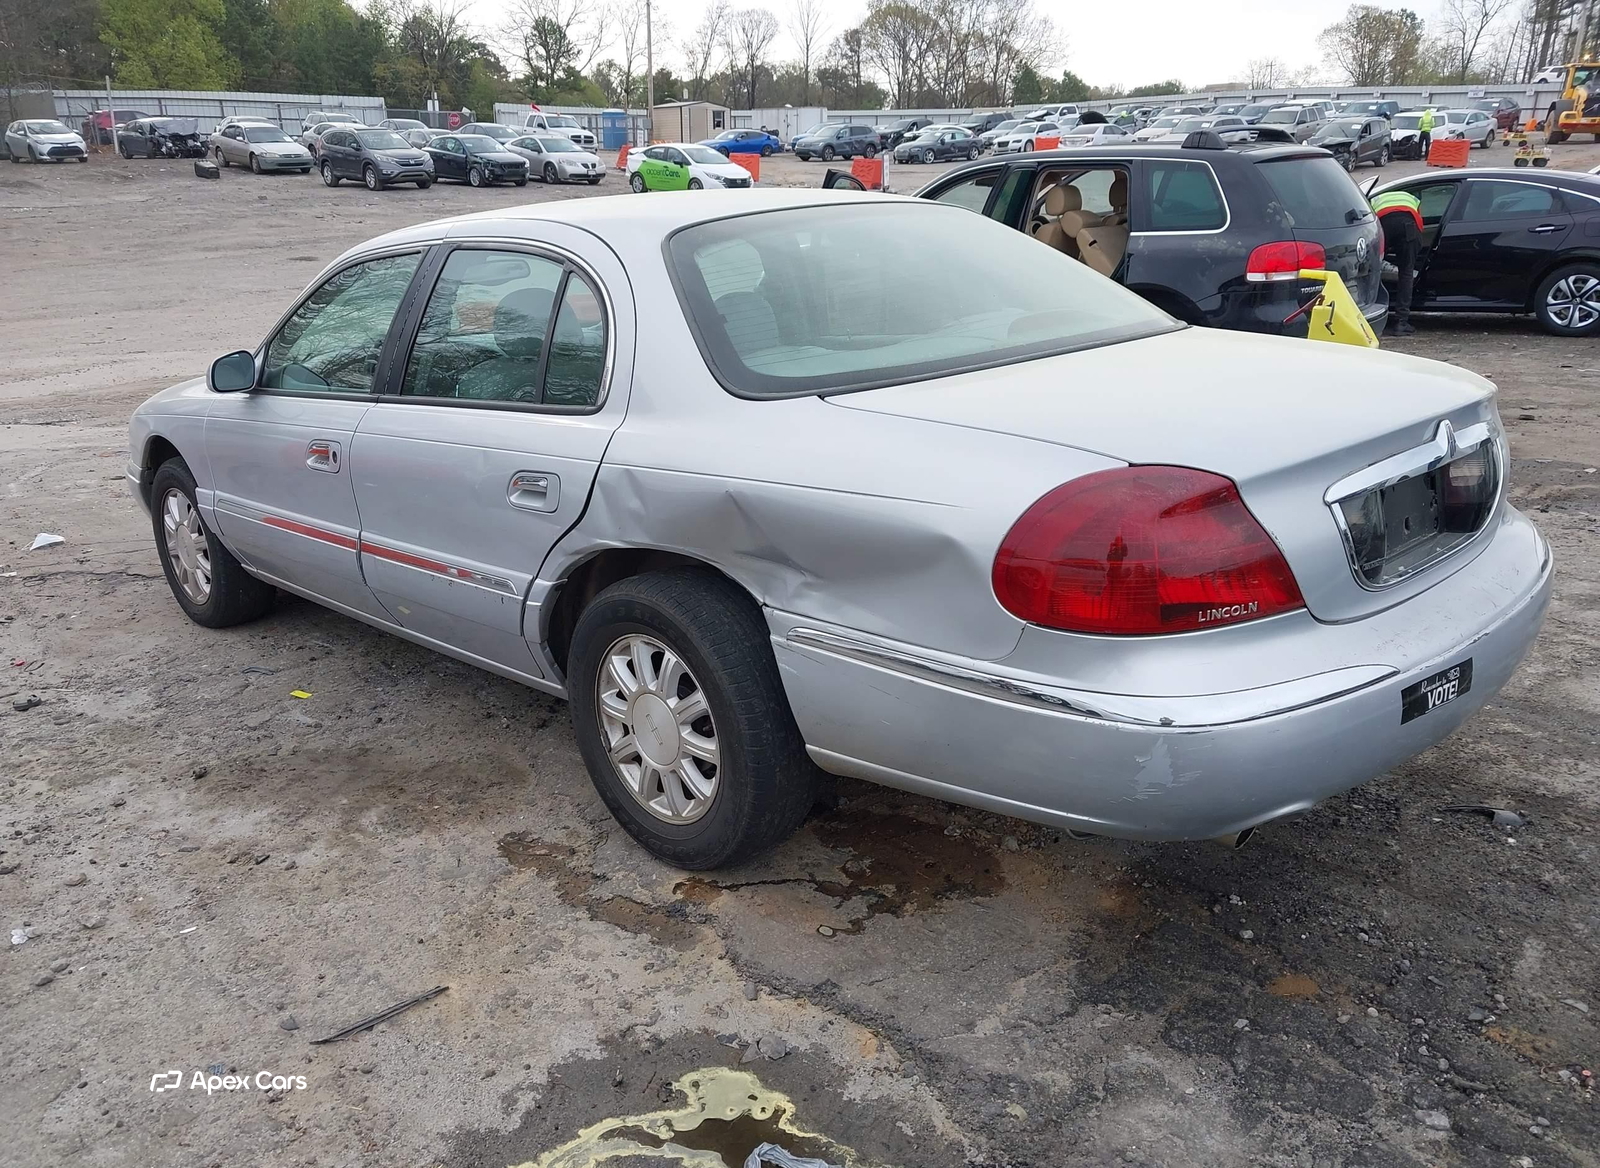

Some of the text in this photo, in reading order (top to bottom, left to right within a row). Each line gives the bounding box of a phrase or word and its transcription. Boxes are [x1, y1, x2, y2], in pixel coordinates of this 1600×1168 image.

[1300, 285, 1325, 294] TOUARE
[1198, 601, 1258, 622] LINCOLN
[1427, 679, 1459, 709] VOTE!
